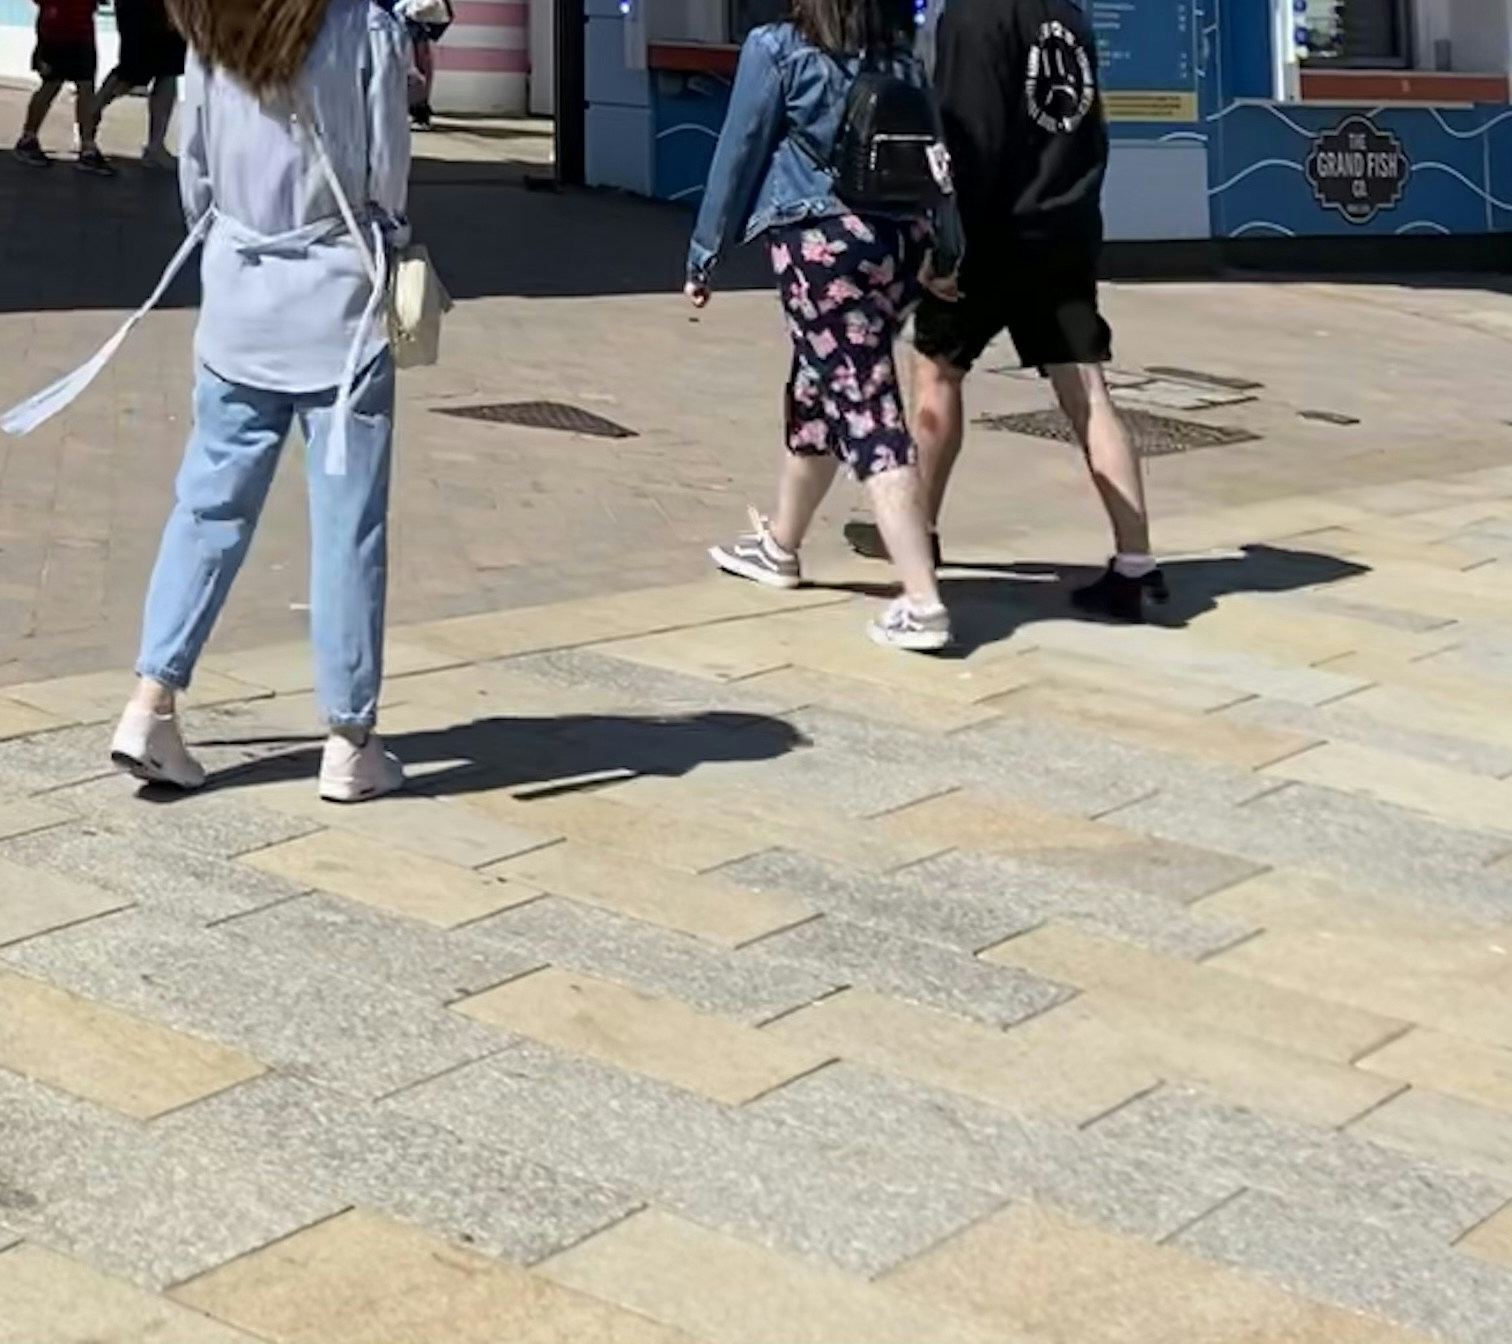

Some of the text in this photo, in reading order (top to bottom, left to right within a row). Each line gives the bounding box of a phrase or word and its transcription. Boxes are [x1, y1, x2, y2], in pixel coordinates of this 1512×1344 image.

[1349, 133, 1366, 150] THE
[1317, 152, 1398, 178] GRAND FISH
